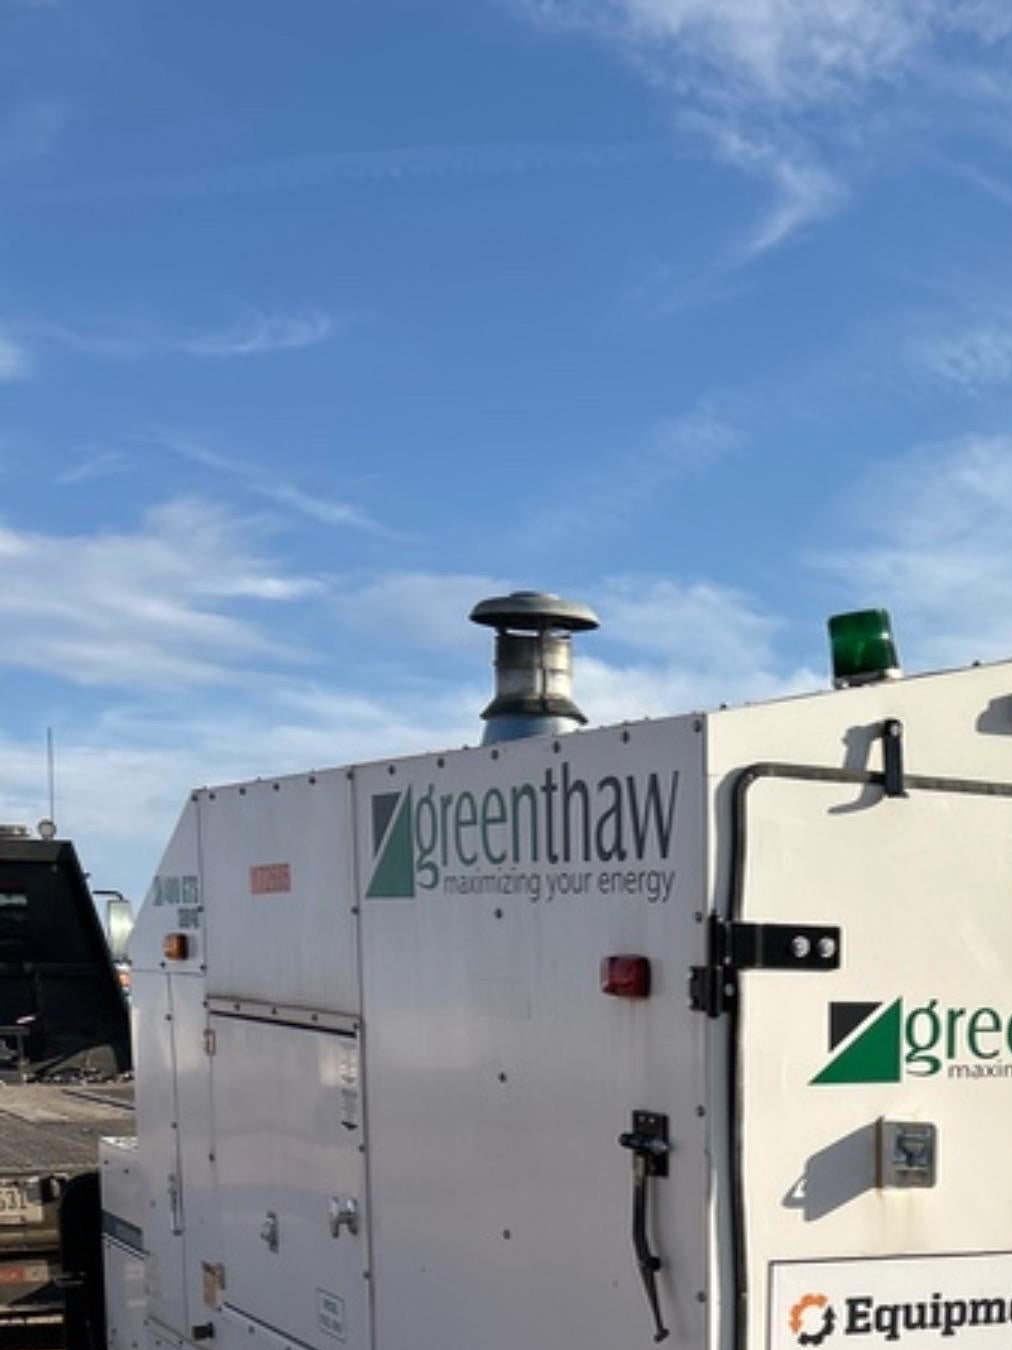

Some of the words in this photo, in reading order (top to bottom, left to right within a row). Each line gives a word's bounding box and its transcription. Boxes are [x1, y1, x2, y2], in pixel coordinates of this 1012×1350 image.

[415, 762, 679, 890] greenthaw
[443, 866, 541, 902] maximizing
[546, 870, 593, 901] your
[599, 867, 677, 904] energy
